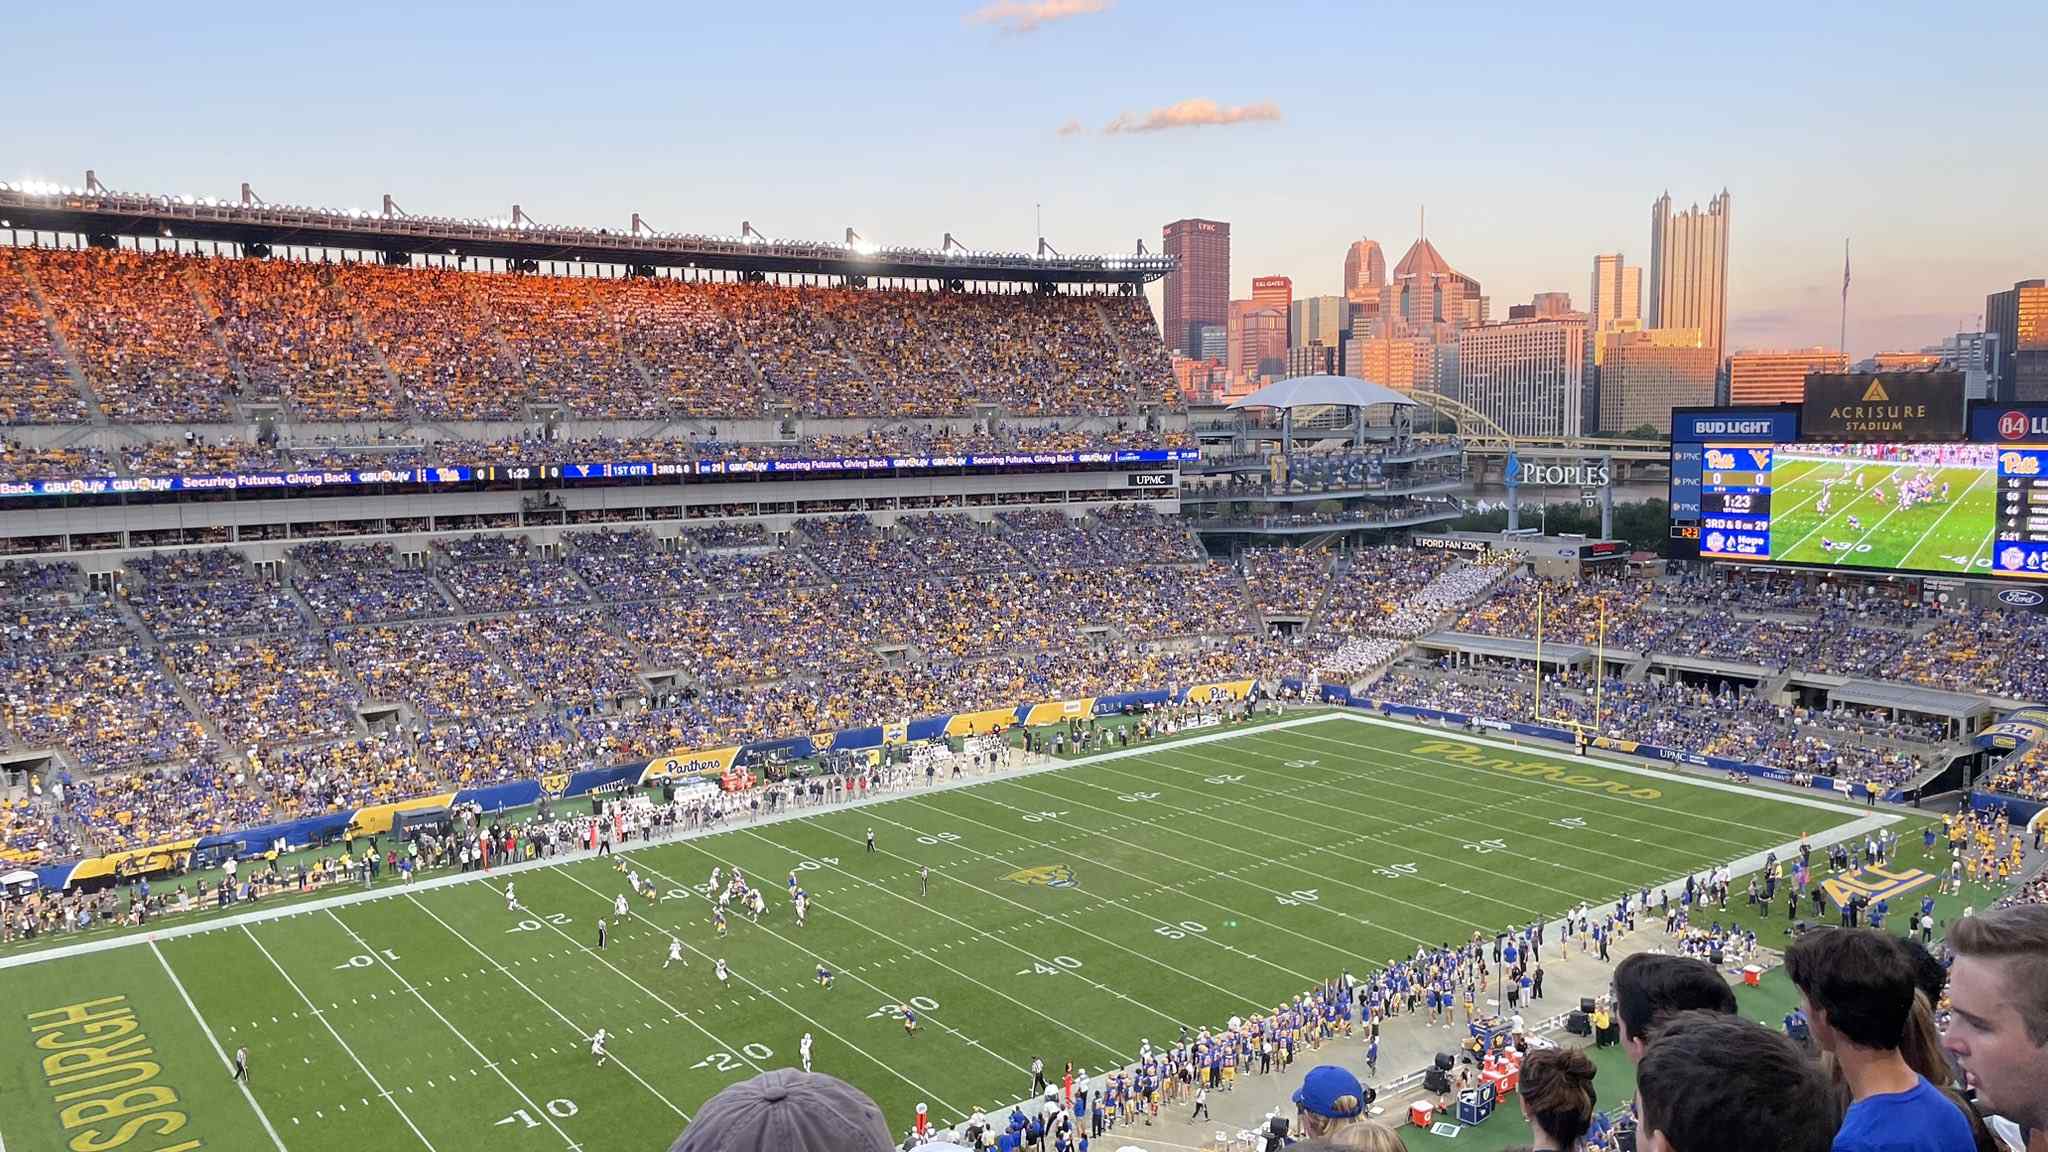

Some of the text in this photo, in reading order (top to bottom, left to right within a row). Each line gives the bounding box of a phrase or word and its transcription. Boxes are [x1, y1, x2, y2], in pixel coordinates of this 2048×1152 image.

[1830, 405, 1926, 418] ACRISURE
[1695, 422, 1770, 434] BUD LIGHT
[1845, 421, 1903, 431] STADIUM
[2001, 417, 2025, 434] 84
[1683, 452, 1701, 461] PNC
[775, 461, 810, 471] Securing
[507, 467, 529, 479] 1:23
[1713, 473, 1721, 485] 0
[0, 482, 34, 494] Back
[183, 476, 237, 489] Securing
[287, 473, 323, 485] Giving
[324, 471, 351, 483] Back
[1136, 475, 1166, 485] UPMC
[1682, 478, 1700, 486] PNC
[1755, 474, 1764, 486] 0
[1723, 494, 1751, 508] 1:23
[1681, 503, 1700, 512] PNC
[1705, 519, 1725, 529] 3RD
[1755, 521, 1768, 531] 29
[1422, 539, 1444, 548] FORD
[1445, 540, 1460, 549] FAN
[1659, 750, 1686, 762] UPMC
[665, 759, 721, 775] Panthers
[1410, 740, 1662, 800] Panthers
[917, 832, 961, 845] 50
[517, 913, 573, 931] 20
[1154, 920, 1208, 940] 50
[1034, 955, 1082, 976] 40
[706, 1043, 774, 1072] 20
[27, 995, 201, 1152] SBURGH
[514, 1098, 578, 1128] 10
